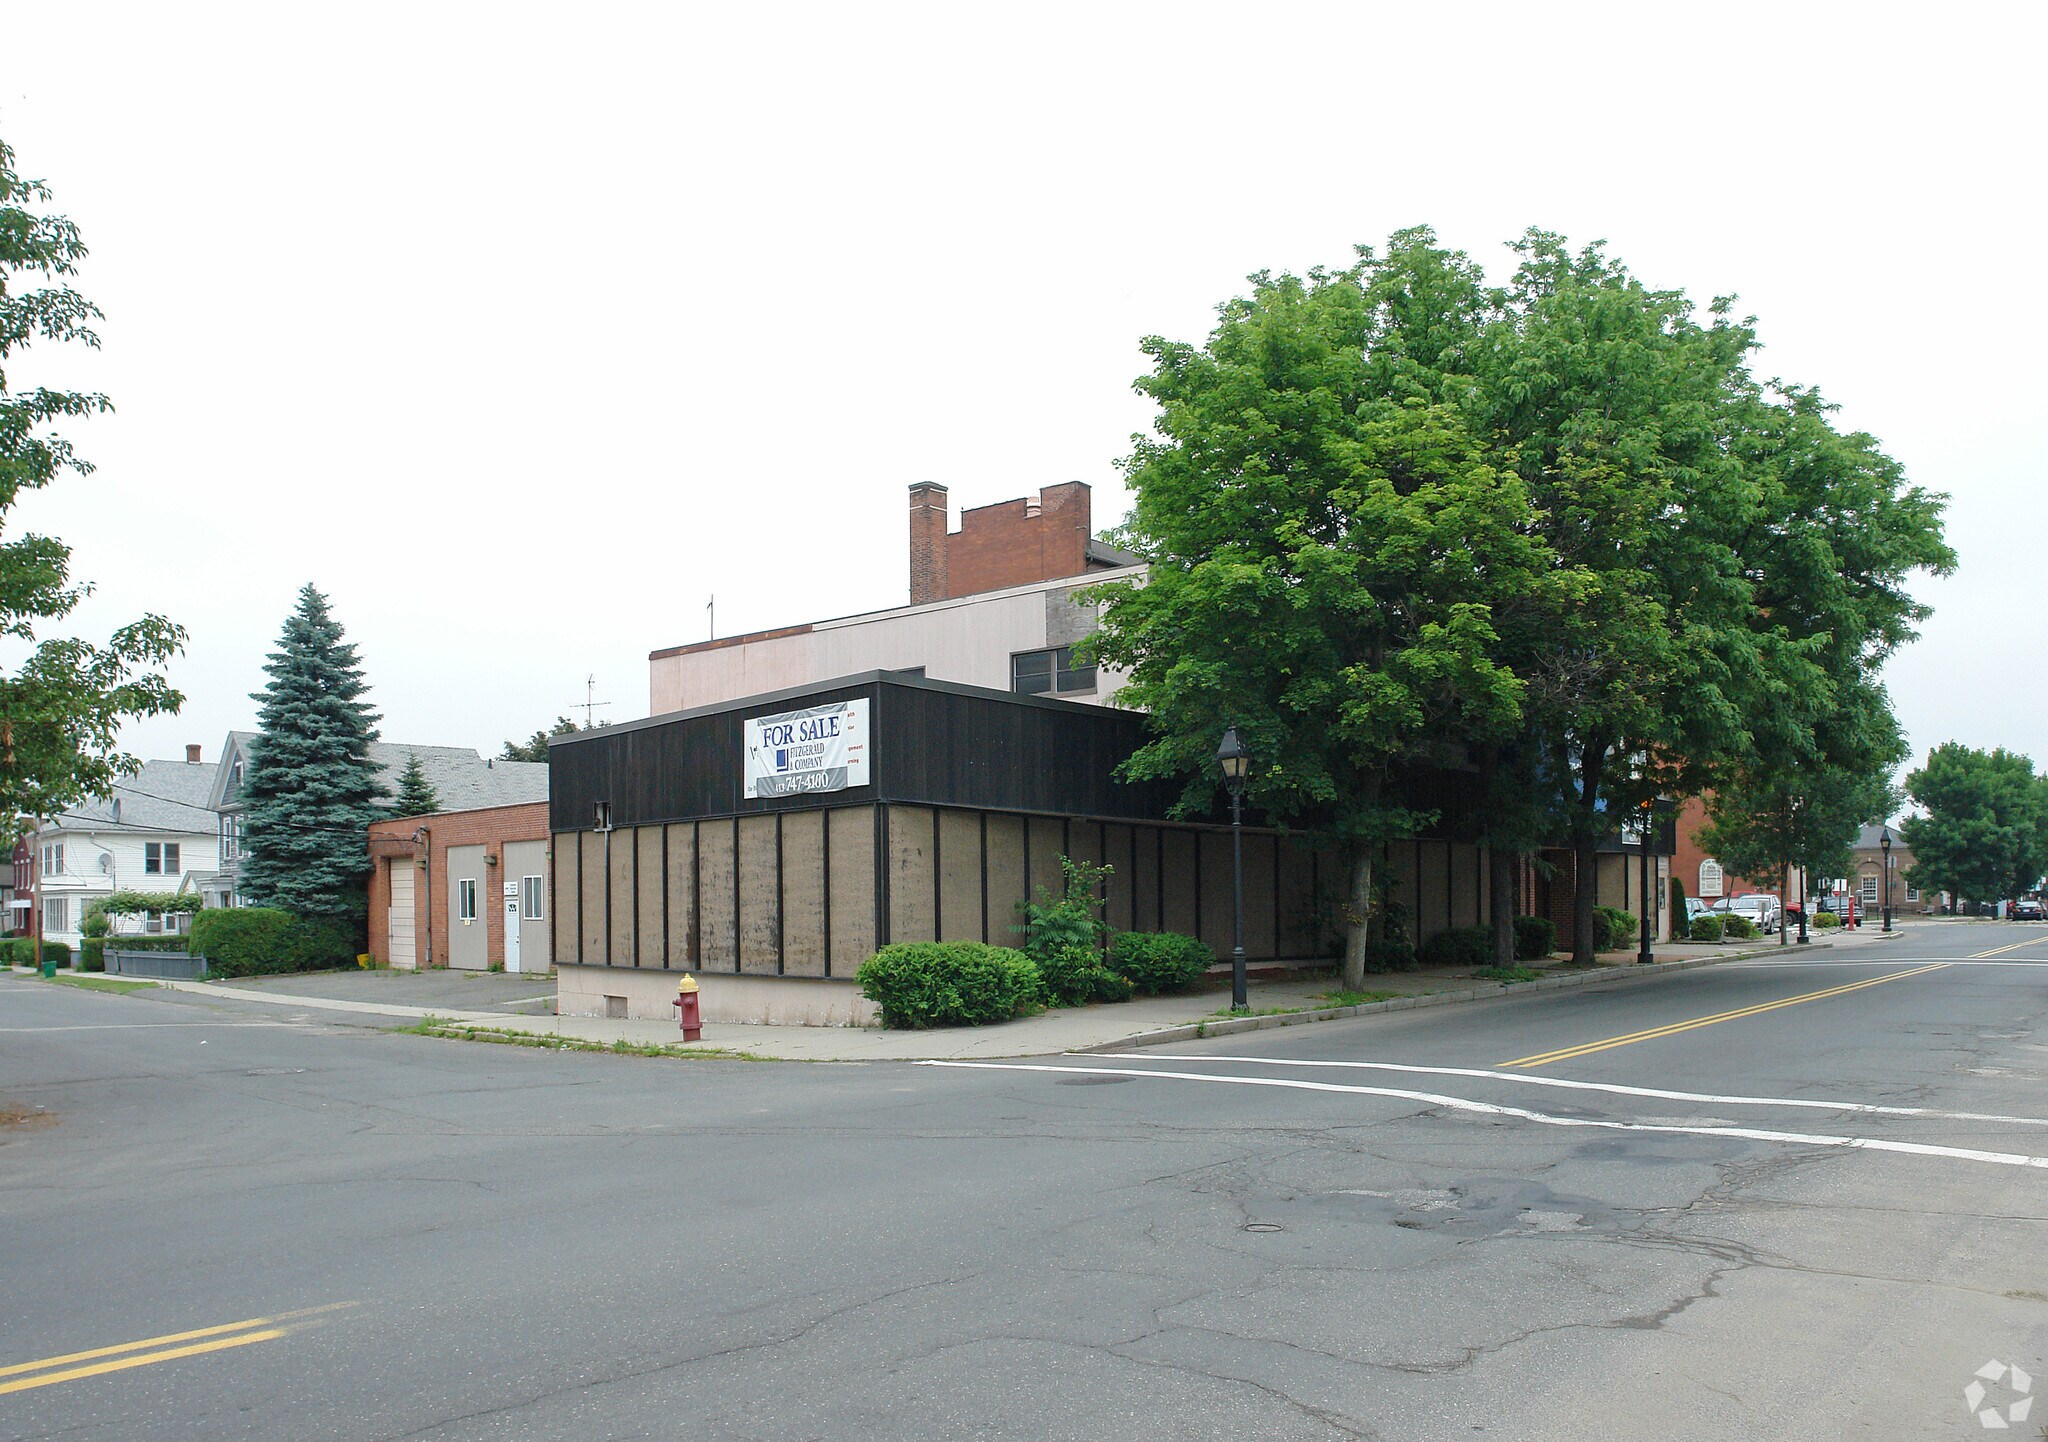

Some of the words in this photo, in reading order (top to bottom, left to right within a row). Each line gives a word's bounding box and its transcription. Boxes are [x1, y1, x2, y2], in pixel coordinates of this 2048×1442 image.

[763, 724, 795, 748] FOR
[799, 716, 840, 742] SALE
[790, 742, 825, 759] FITZGERALD
[794, 756, 823, 771] COMPANY
[785, 772, 829, 792] 747-4100
